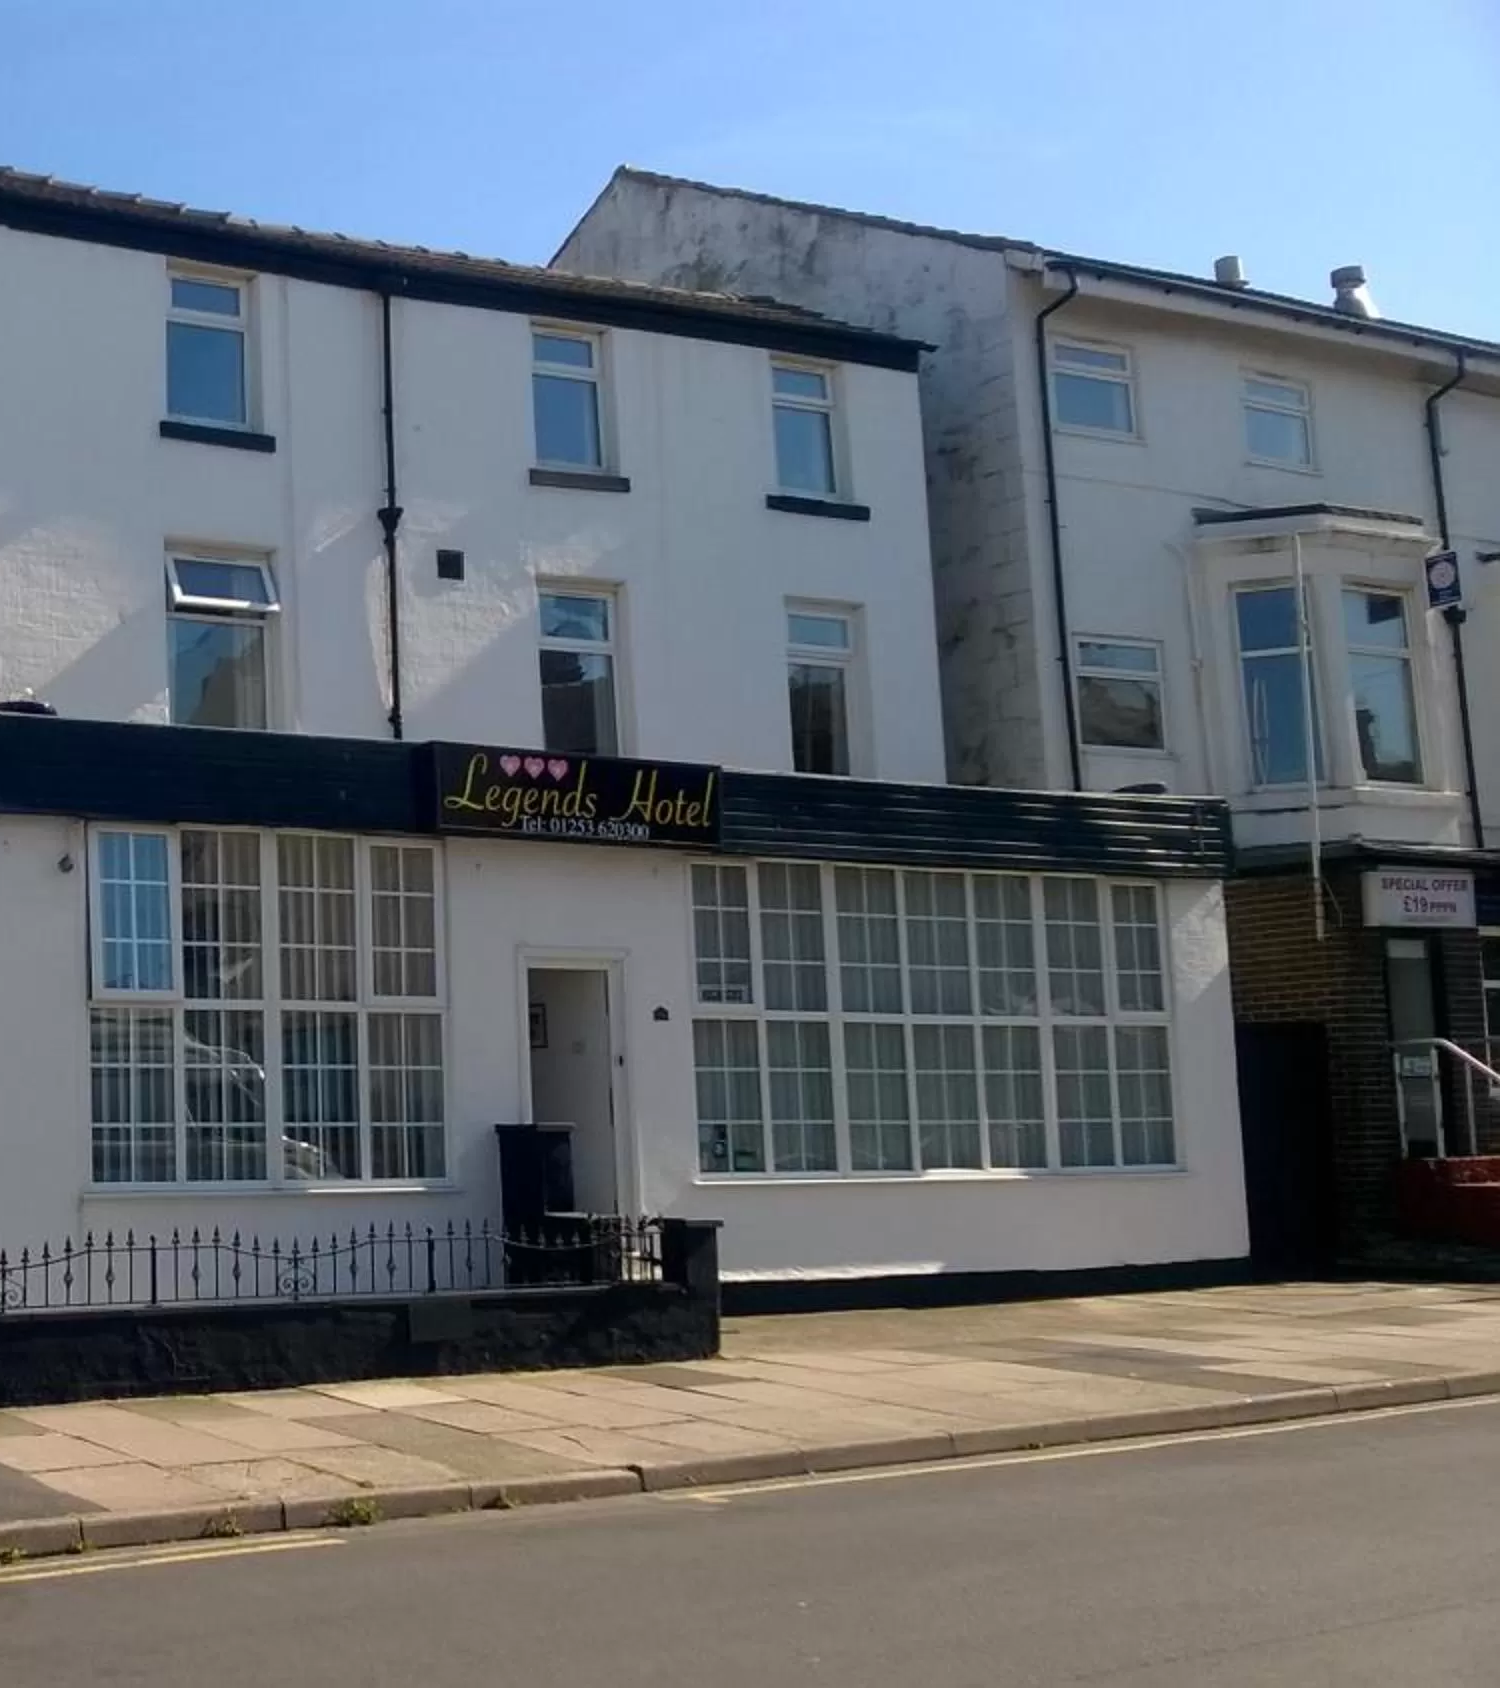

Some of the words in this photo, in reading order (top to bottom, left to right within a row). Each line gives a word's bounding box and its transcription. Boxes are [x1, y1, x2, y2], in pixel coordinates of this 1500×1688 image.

[443, 752, 597, 827] Legends
[609, 769, 715, 828] Hotel
[520, 815, 546, 833] Tel:
[549, 817, 594, 836] 01253
[597, 820, 650, 840] 620300
[1381, 877, 1428, 891] SPECIAL
[1431, 879, 1468, 891] OFFER
